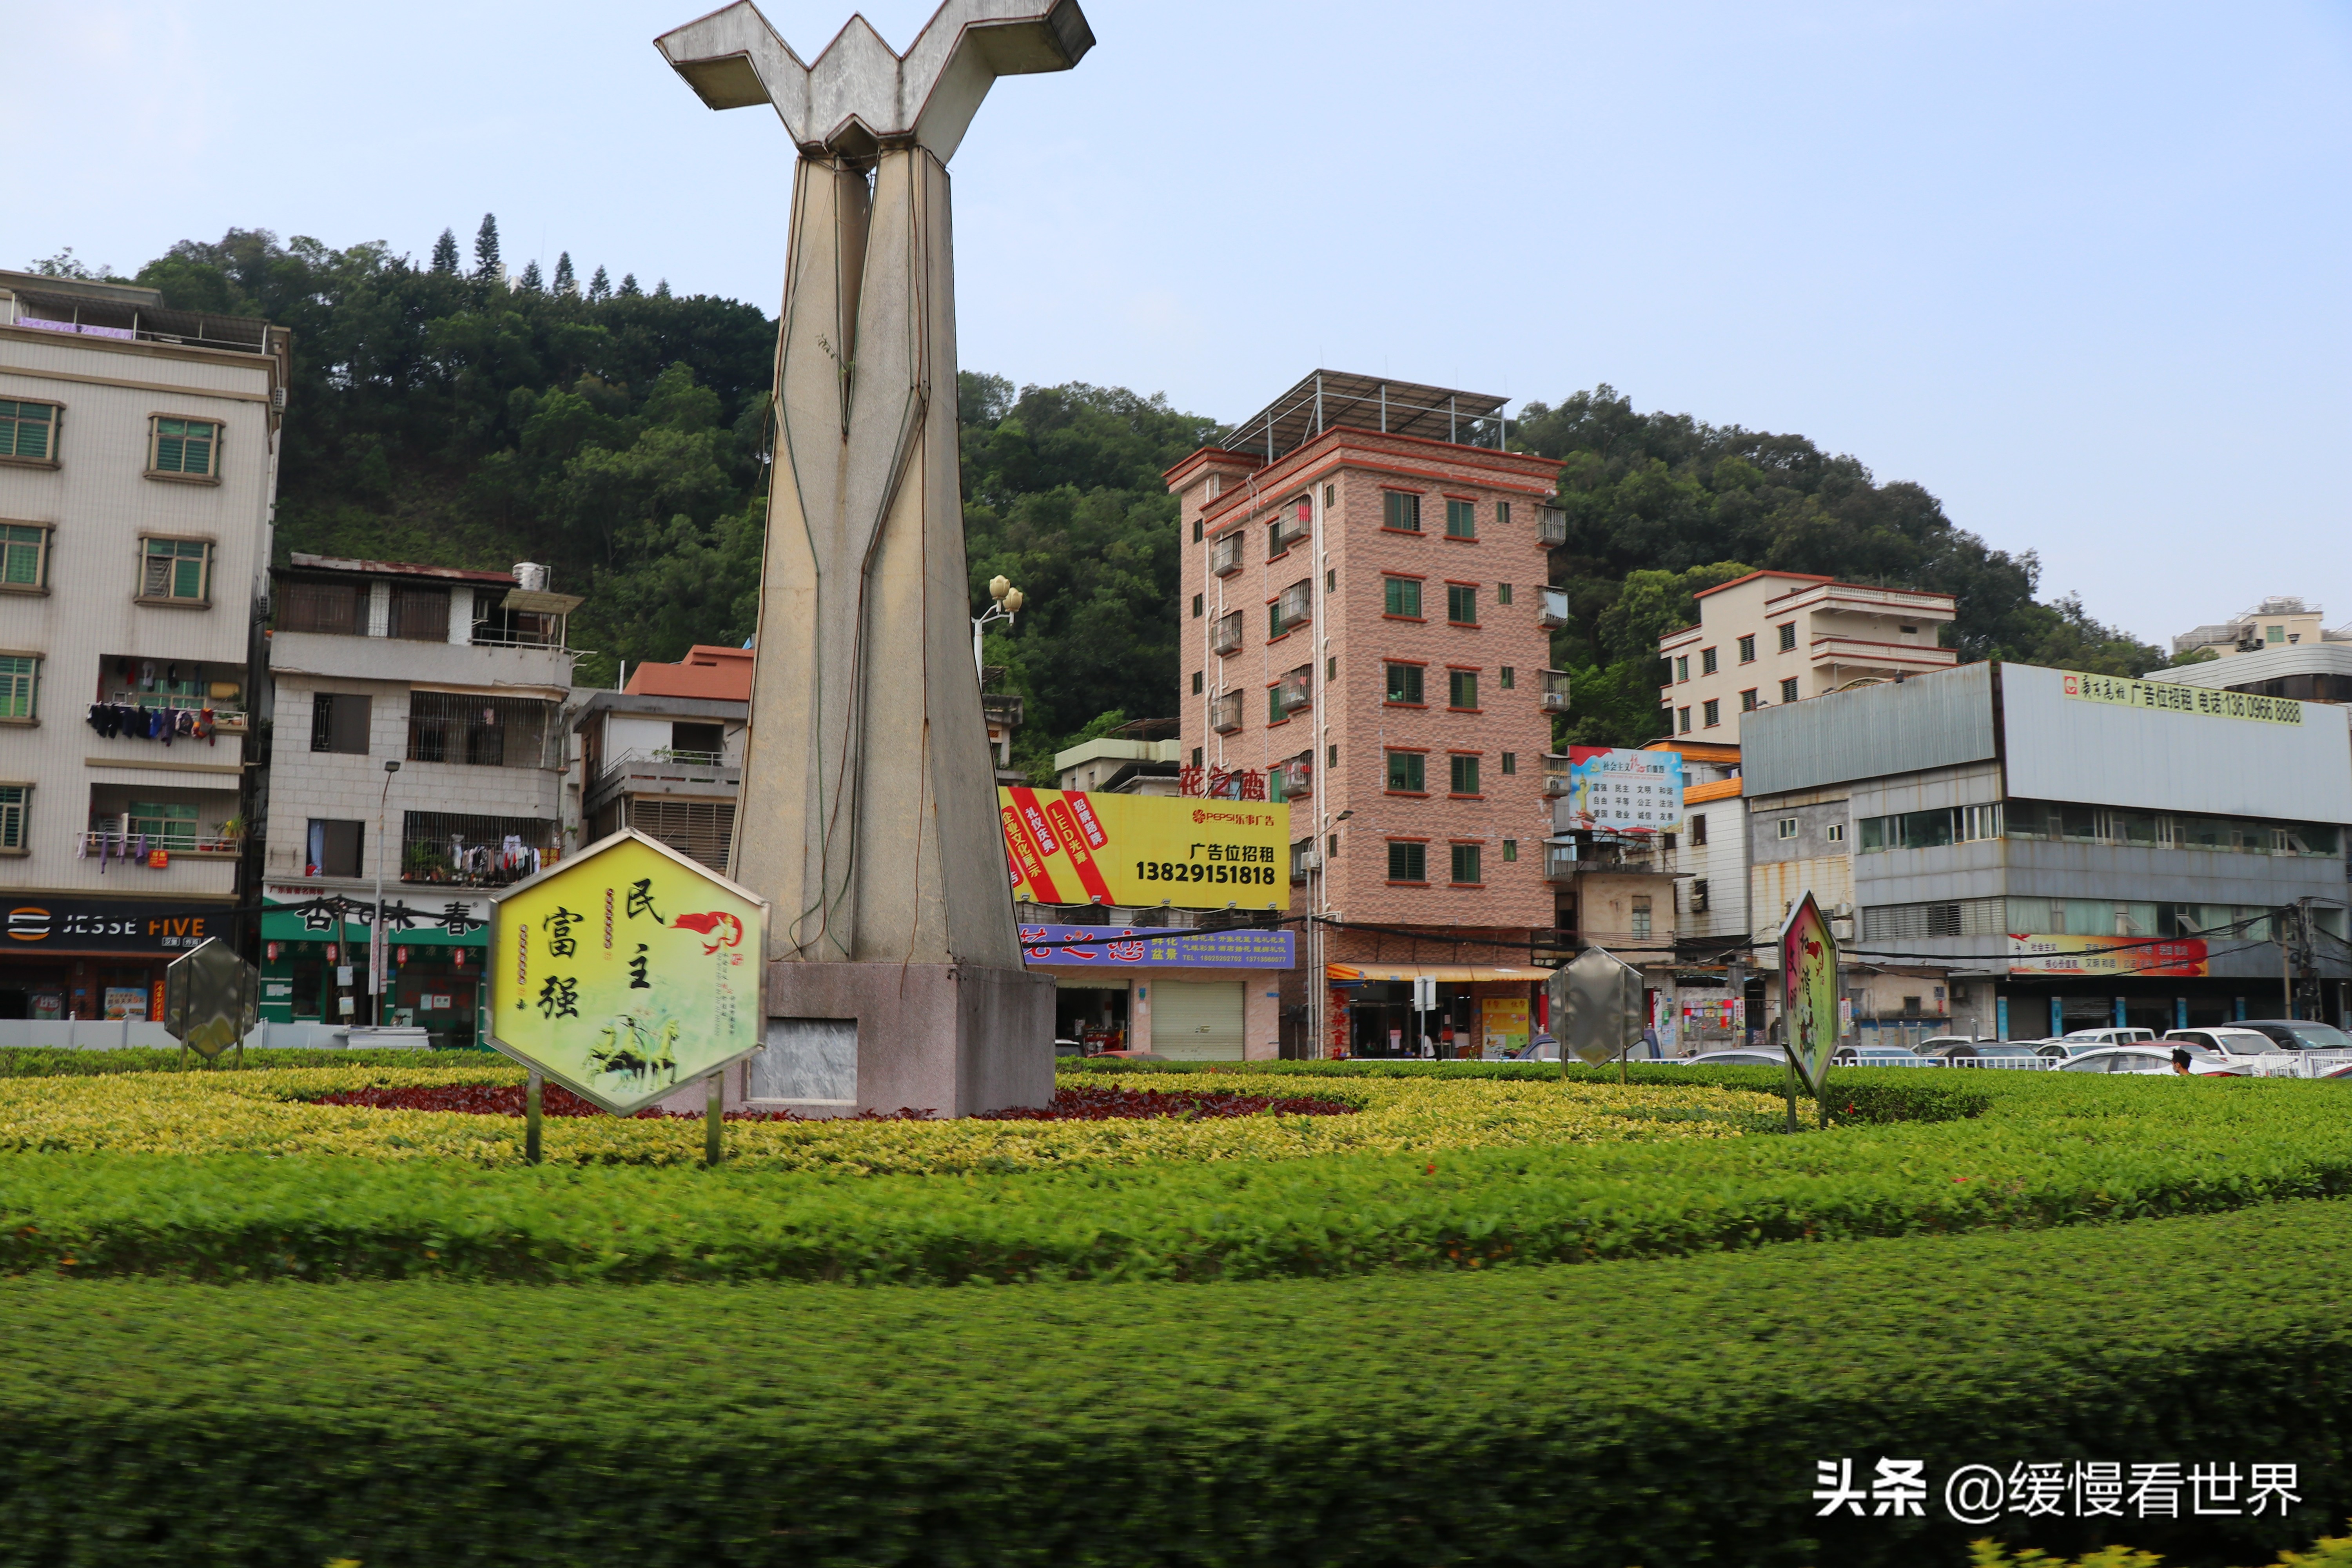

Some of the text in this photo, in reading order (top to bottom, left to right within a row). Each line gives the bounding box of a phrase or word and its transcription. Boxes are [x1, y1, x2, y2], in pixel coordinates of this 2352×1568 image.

[2131, 682, 2192, 710] 广告位招租
[2247, 696, 2273, 720] 0966
[2275, 699, 2301, 724] 8888
[1178, 764, 1268, 800] 花之恋
[1593, 783, 1673, 795] 富强 民主 文明 和谐
[1593, 796, 1673, 808] 自由 平等 公正 法治
[1073, 798, 1103, 846] 招牌路牌
[1206, 813, 1274, 826] PEPSI 乐事广告
[1593, 809, 1674, 821] 爱国 敬业 诚信 友善
[1025, 806, 1056, 854] 礼仪庆典
[1051, 808, 1088, 865] LED光源
[1002, 811, 1042, 878] 企业文化展示
[1190, 843, 1274, 862] 广告位招租
[1137, 861, 1275, 885] 13829151818
[62, 915, 205, 936] JESSE FIVE
[627, 878, 665, 989] 民主
[1020, 927, 1145, 962] 花之恋
[1151, 948, 1178, 960] 盆景
[2031, 942, 2057, 952] 社会主义
[537, 906, 584, 1019] 富强
[2045, 959, 2078, 968] 核心价值观
[2085, 958, 2100, 968] 文明
